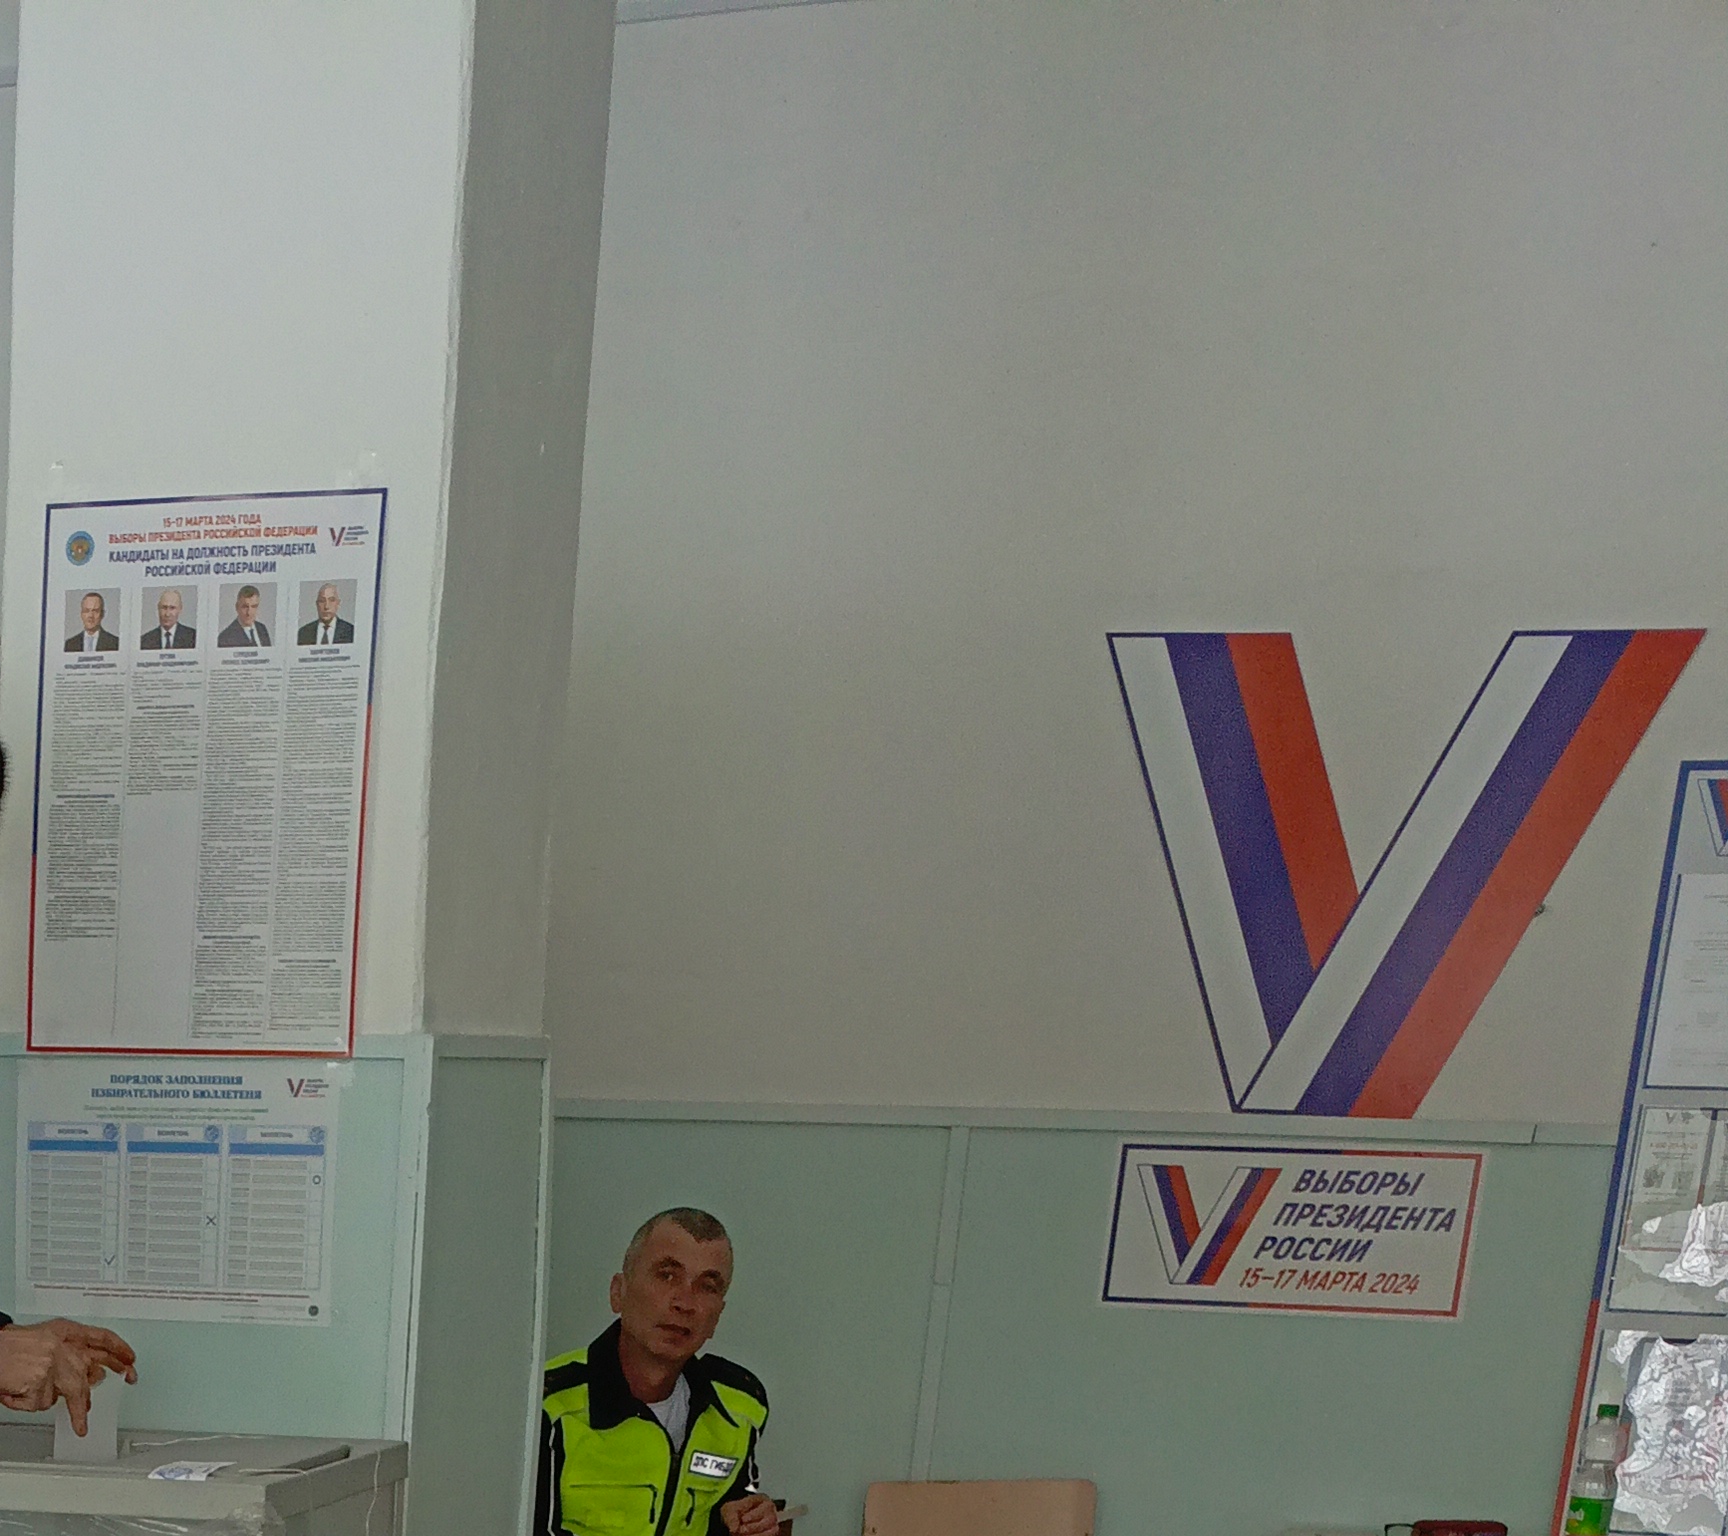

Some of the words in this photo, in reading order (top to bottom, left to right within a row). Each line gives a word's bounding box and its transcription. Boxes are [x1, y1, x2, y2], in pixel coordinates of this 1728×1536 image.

[187, 516, 214, 527] МАРТА
[216, 515, 237, 526] 2024
[238, 514, 261, 525] ГОДА
[109, 532, 146, 544] ВЫБОРЫ
[148, 530, 202, 542] ПРЕЗИДЕНТА
[203, 527, 262, 540] РОССИЙСКОЙ
[264, 525, 318, 538] ФЕДЕРАЦИИ
[109, 549, 170, 563] КАНДИДАТЫ
[172, 548, 185, 560] НА
[187, 545, 249, 560] ДОЛЖНОСТЬ
[251, 542, 316, 557] ПРЕЗИДЕНТА
[145, 562, 211, 577] РОССИЙСКОЙ
[213, 560, 277, 574] ФЕДЕРАЦИИ
[110, 1074, 163, 1086] ПОРЯДОК
[166, 1074, 243, 1086] ЗАПОЛНЕНИЯ
[91, 1088, 190, 1100] ИЗБИРАТЕЛЬНОГО
[192, 1089, 262, 1100] БЮЛЛЕТЕНЯ
[1292, 1168, 1425, 1197] ВЫБОРЫ
[1273, 1202, 1457, 1233] ПРЕЗИДЕНТА
[1253, 1236, 1373, 1263] РОССИИ
[1300, 1271, 1368, 1293] МАРТА
[1369, 1273, 1422, 1295] 2024
